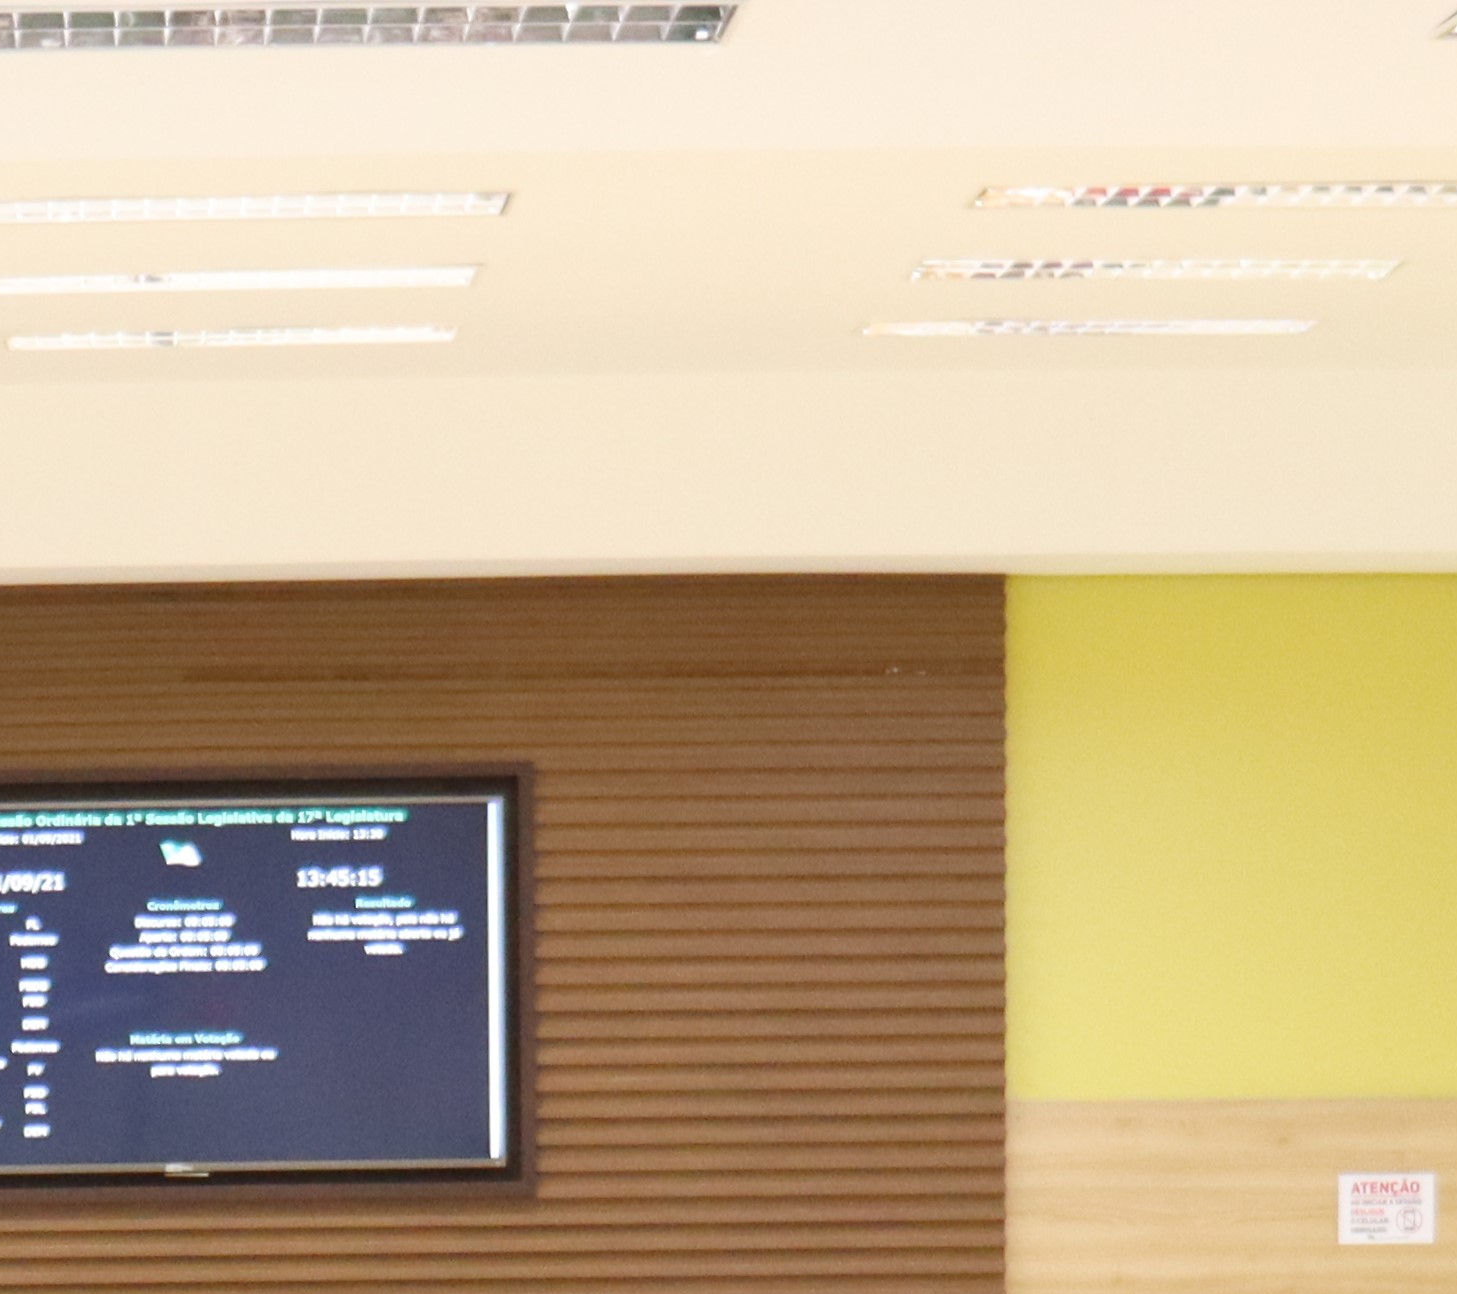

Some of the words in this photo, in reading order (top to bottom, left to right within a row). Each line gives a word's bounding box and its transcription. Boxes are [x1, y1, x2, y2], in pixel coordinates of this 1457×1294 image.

[35, 813, 102, 828] Ordinária
[104, 813, 123, 826] da
[145, 812, 195, 826] Sessão
[197, 811, 273, 827] Legislativa
[275, 811, 294, 824] da
[325, 810, 404, 826] Legislatura
[296, 866, 384, 888] 13:45:15
[146, 900, 220, 912] Cronômetros
[355, 897, 413, 909] Resultado
[129, 1033, 173, 1045] Matéria
[194, 1032, 241, 1047] Votação
[1351, 1178, 1421, 1197] ATENÇÃO
